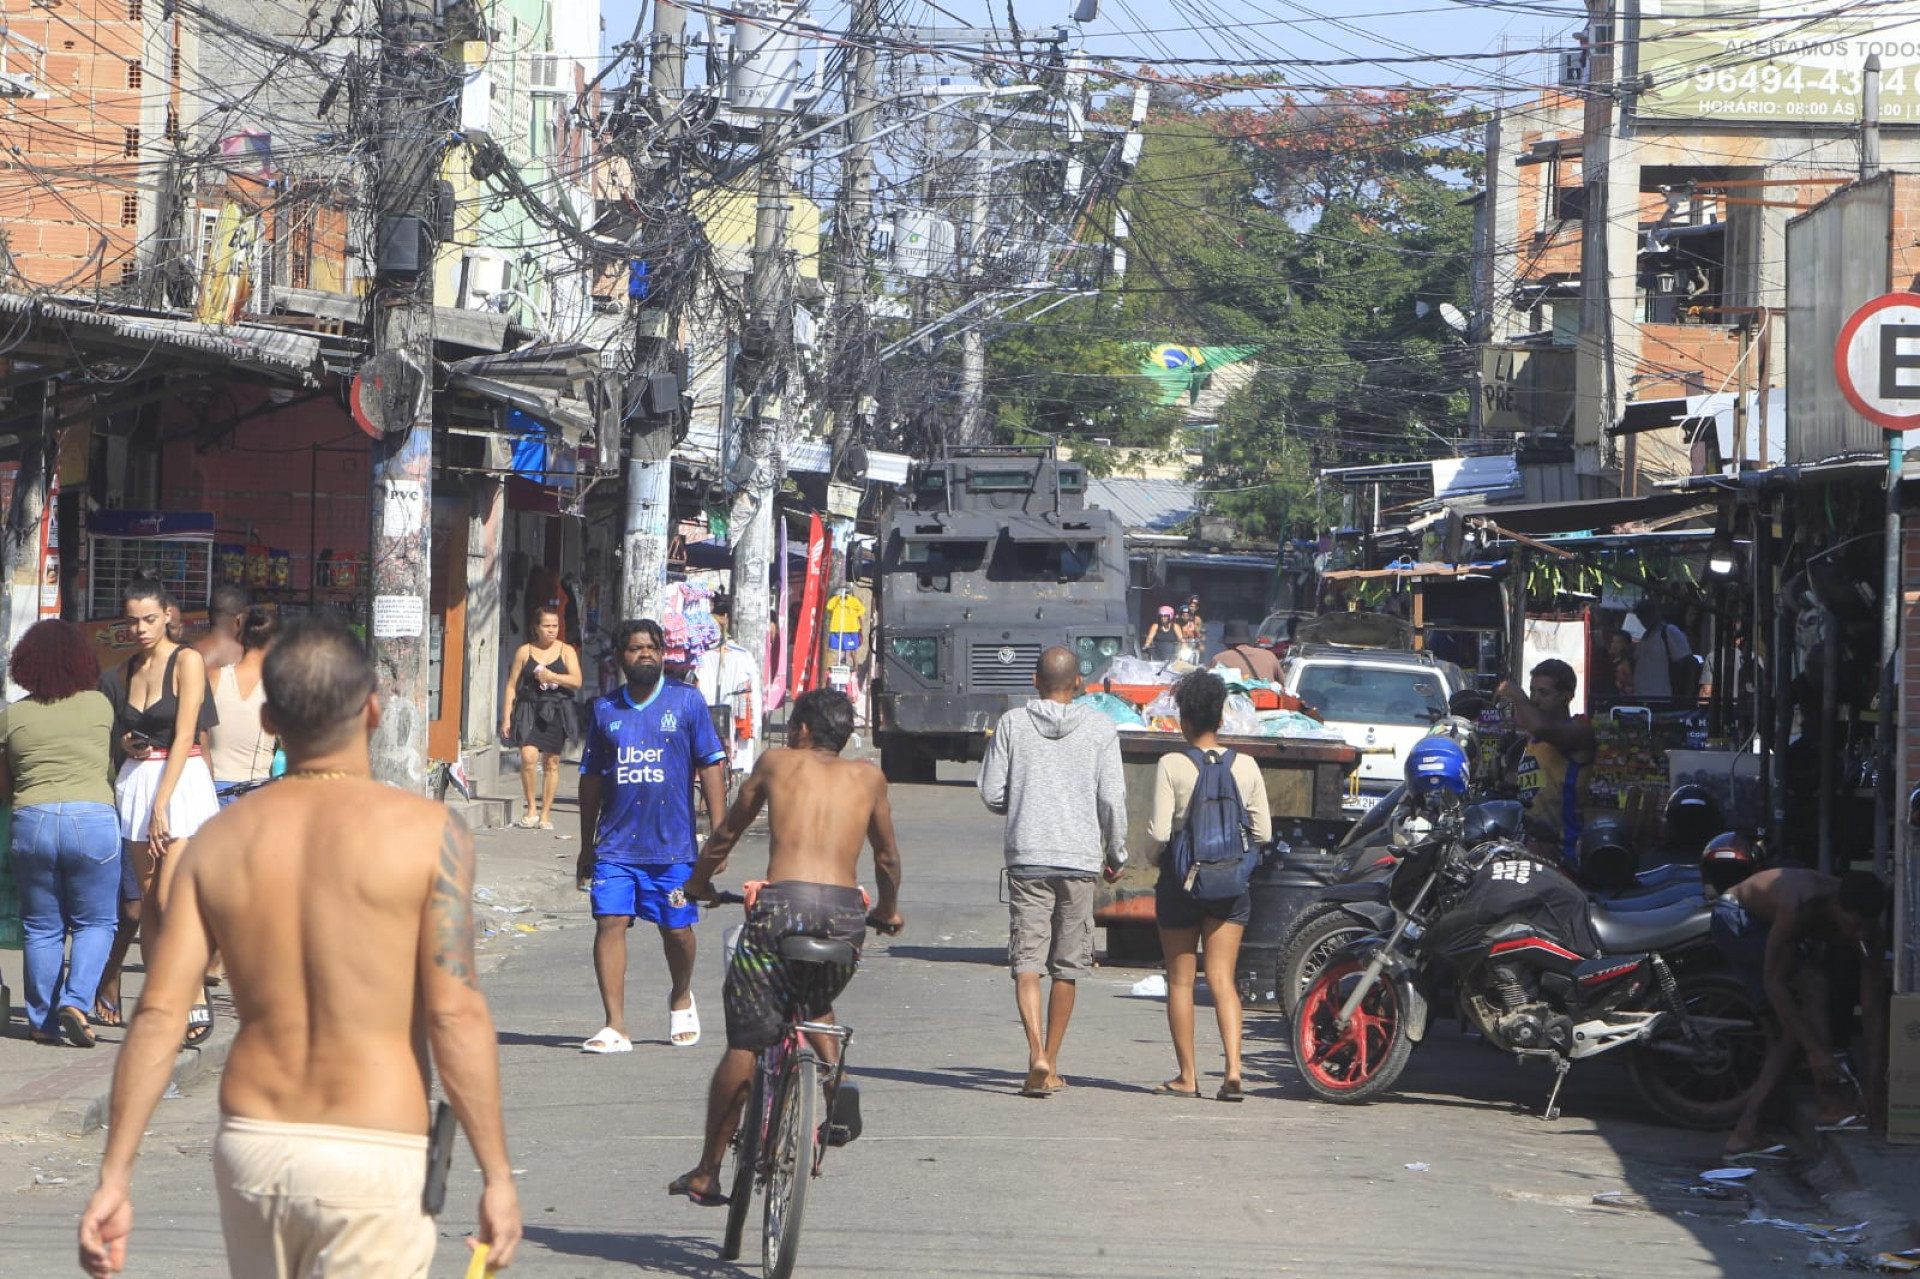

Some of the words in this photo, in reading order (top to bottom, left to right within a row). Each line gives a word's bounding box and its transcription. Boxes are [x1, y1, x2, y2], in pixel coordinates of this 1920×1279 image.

[1725, 39, 1849, 57] ACEITAMOS
[1694, 64, 1907, 97] 96494-434
[1698, 98, 1782, 114] HORÁRIO:
[1786, 101, 1828, 115] 08:00
[1880, 324, 1920, 399] E
[390, 490, 419, 501] PVC
[617, 746, 664, 765] Uber
[617, 765, 665, 785] Eats
[188, 1009, 210, 1023] IKE
